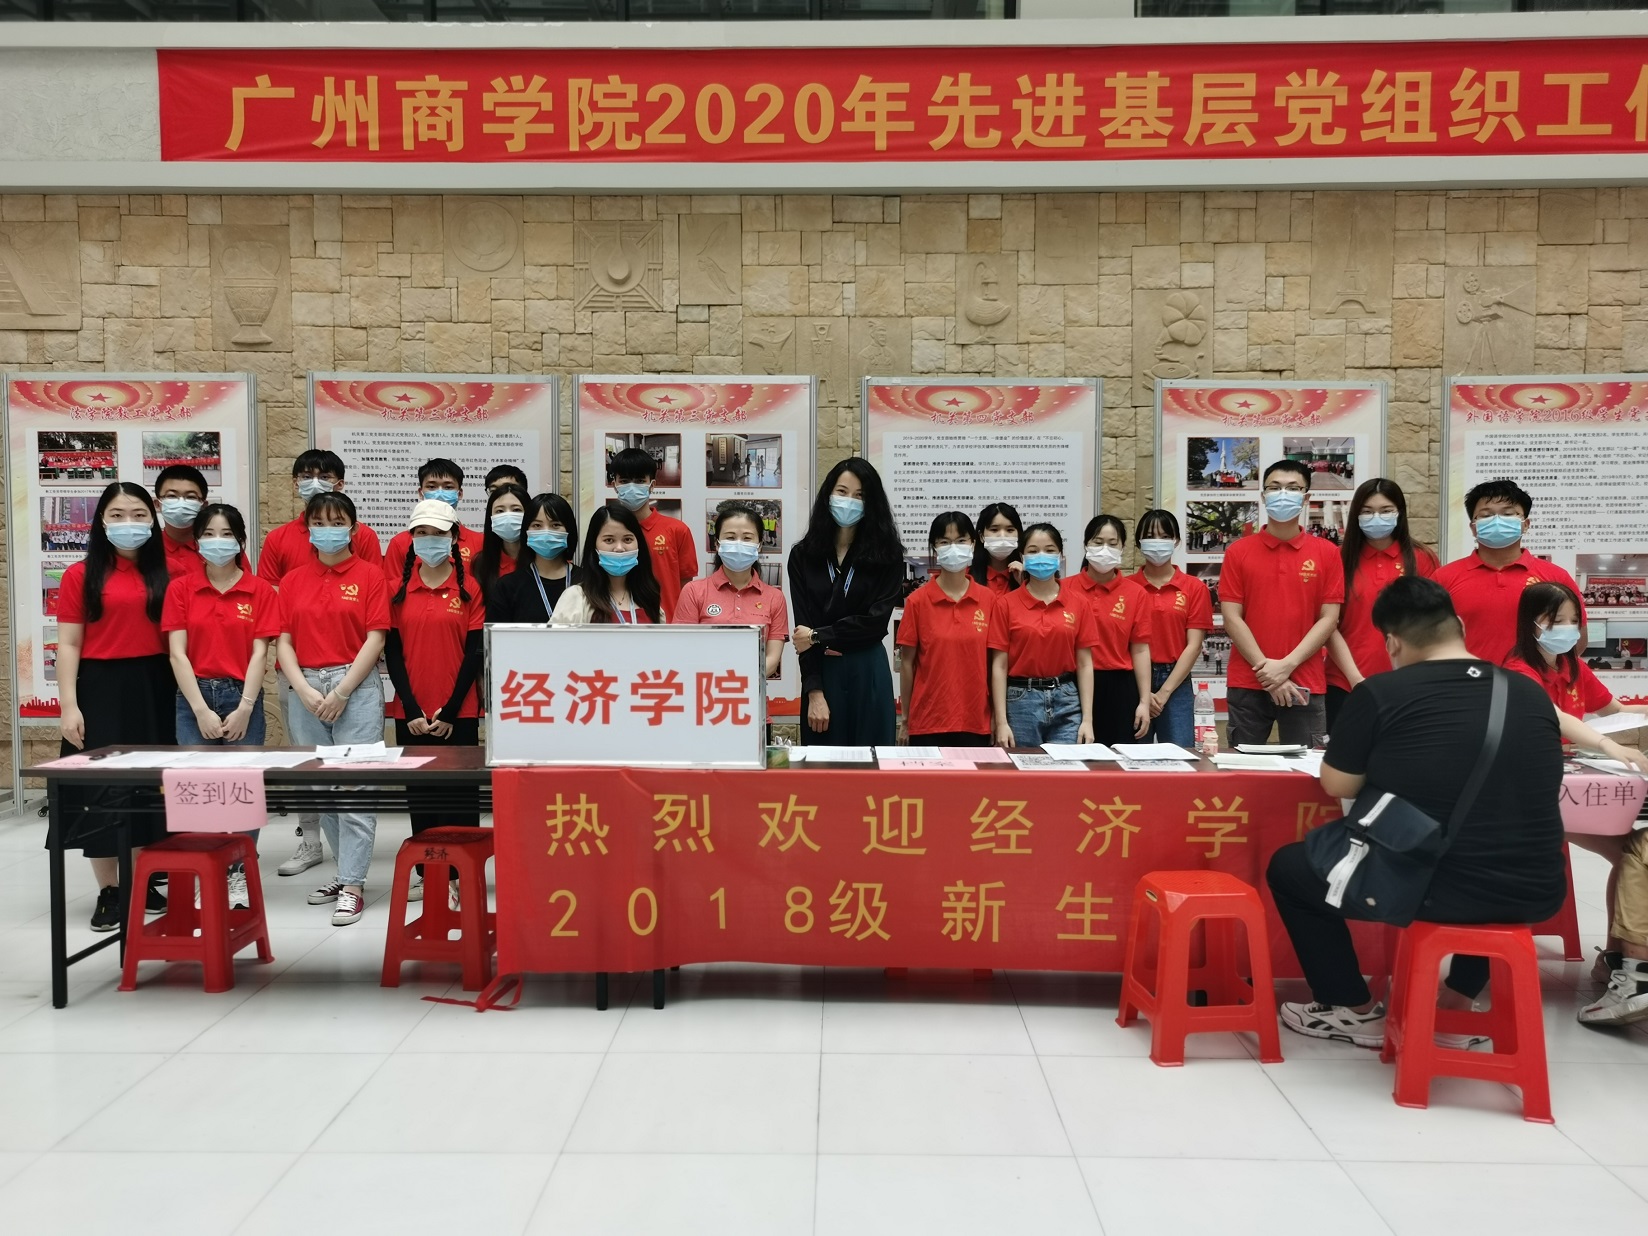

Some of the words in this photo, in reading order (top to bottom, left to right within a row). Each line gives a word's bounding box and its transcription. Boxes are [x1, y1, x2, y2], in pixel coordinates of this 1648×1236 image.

[69, 406, 193, 422] 法学院教工党支部
[381, 407, 489, 423] 机关第三党支部
[641, 408, 748, 424] 机关第三党支部
[930, 409, 1035, 427] 机关第四党支部
[1220, 411, 1322, 428] 机关第四党支部
[1465, 406, 1648, 424] 外国语学院2016级学生党
[499, 669, 752, 726] 经济学院
[173, 780, 255, 806] 签到处
[1559, 780, 1638, 808] 入住单
[548, 879, 1118, 943] 2018级新生
